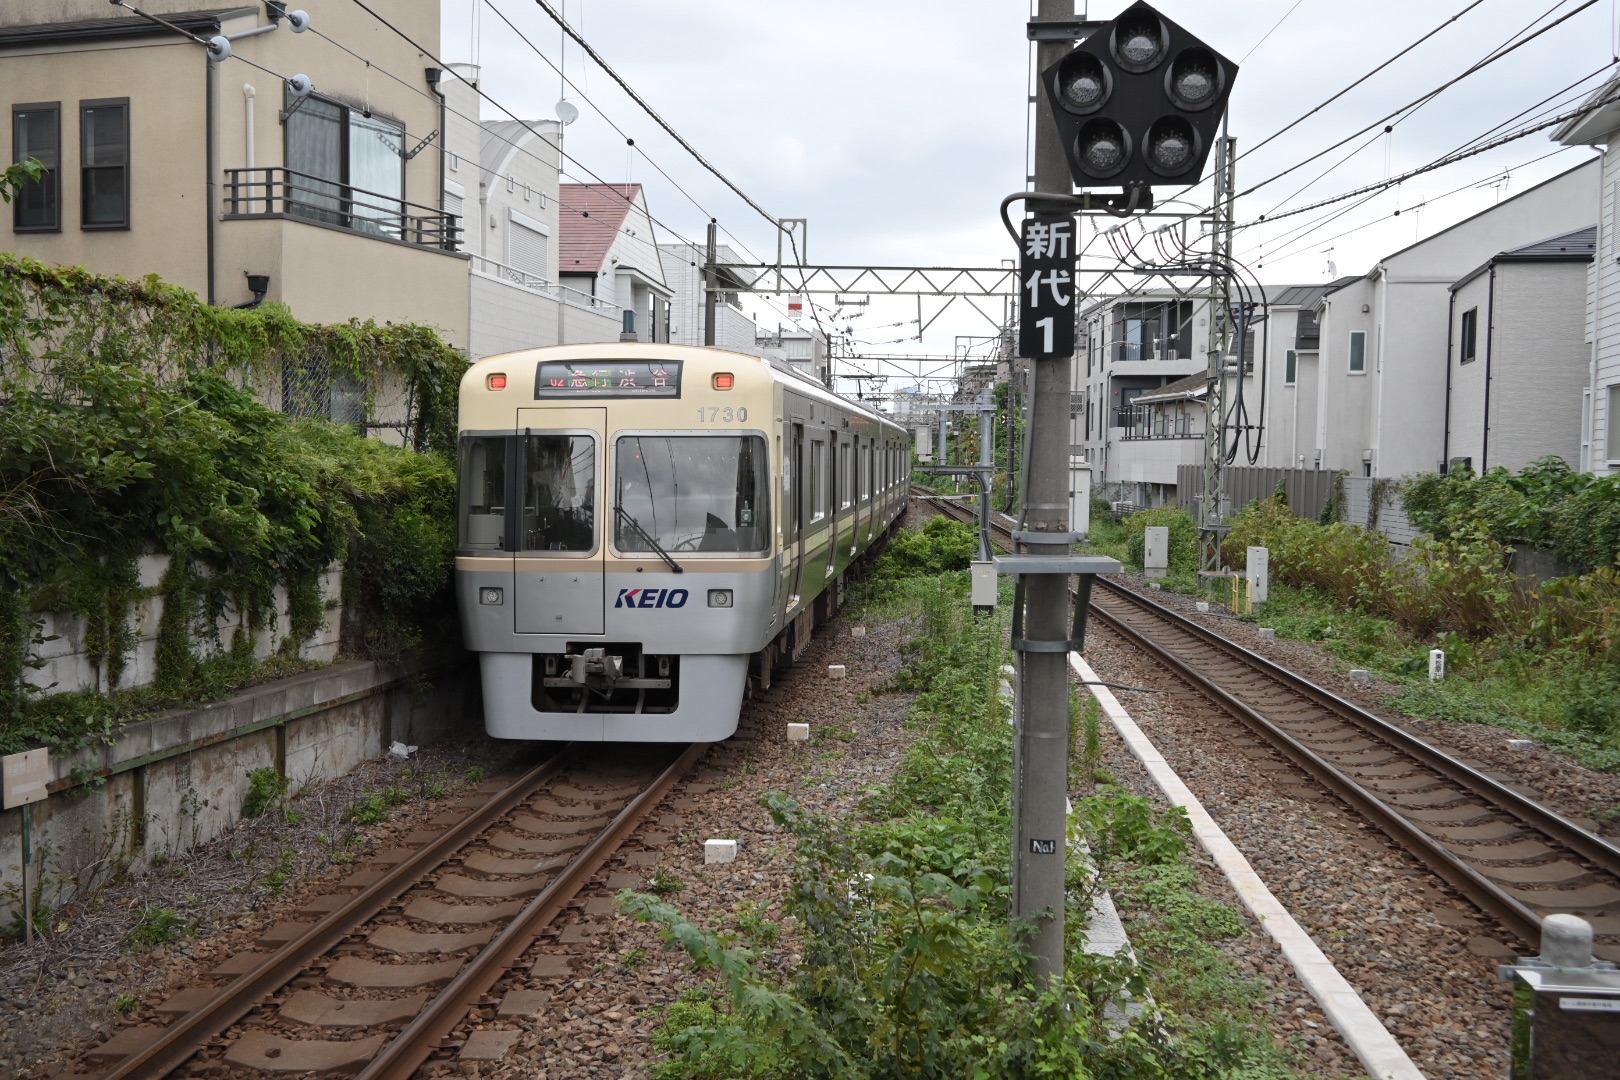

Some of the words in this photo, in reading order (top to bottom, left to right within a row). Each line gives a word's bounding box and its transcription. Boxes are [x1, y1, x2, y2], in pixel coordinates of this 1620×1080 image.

[1025, 221, 1071, 353] 新代1
[697, 406, 748, 423] 1730
[614, 588, 689, 609] KEIO
